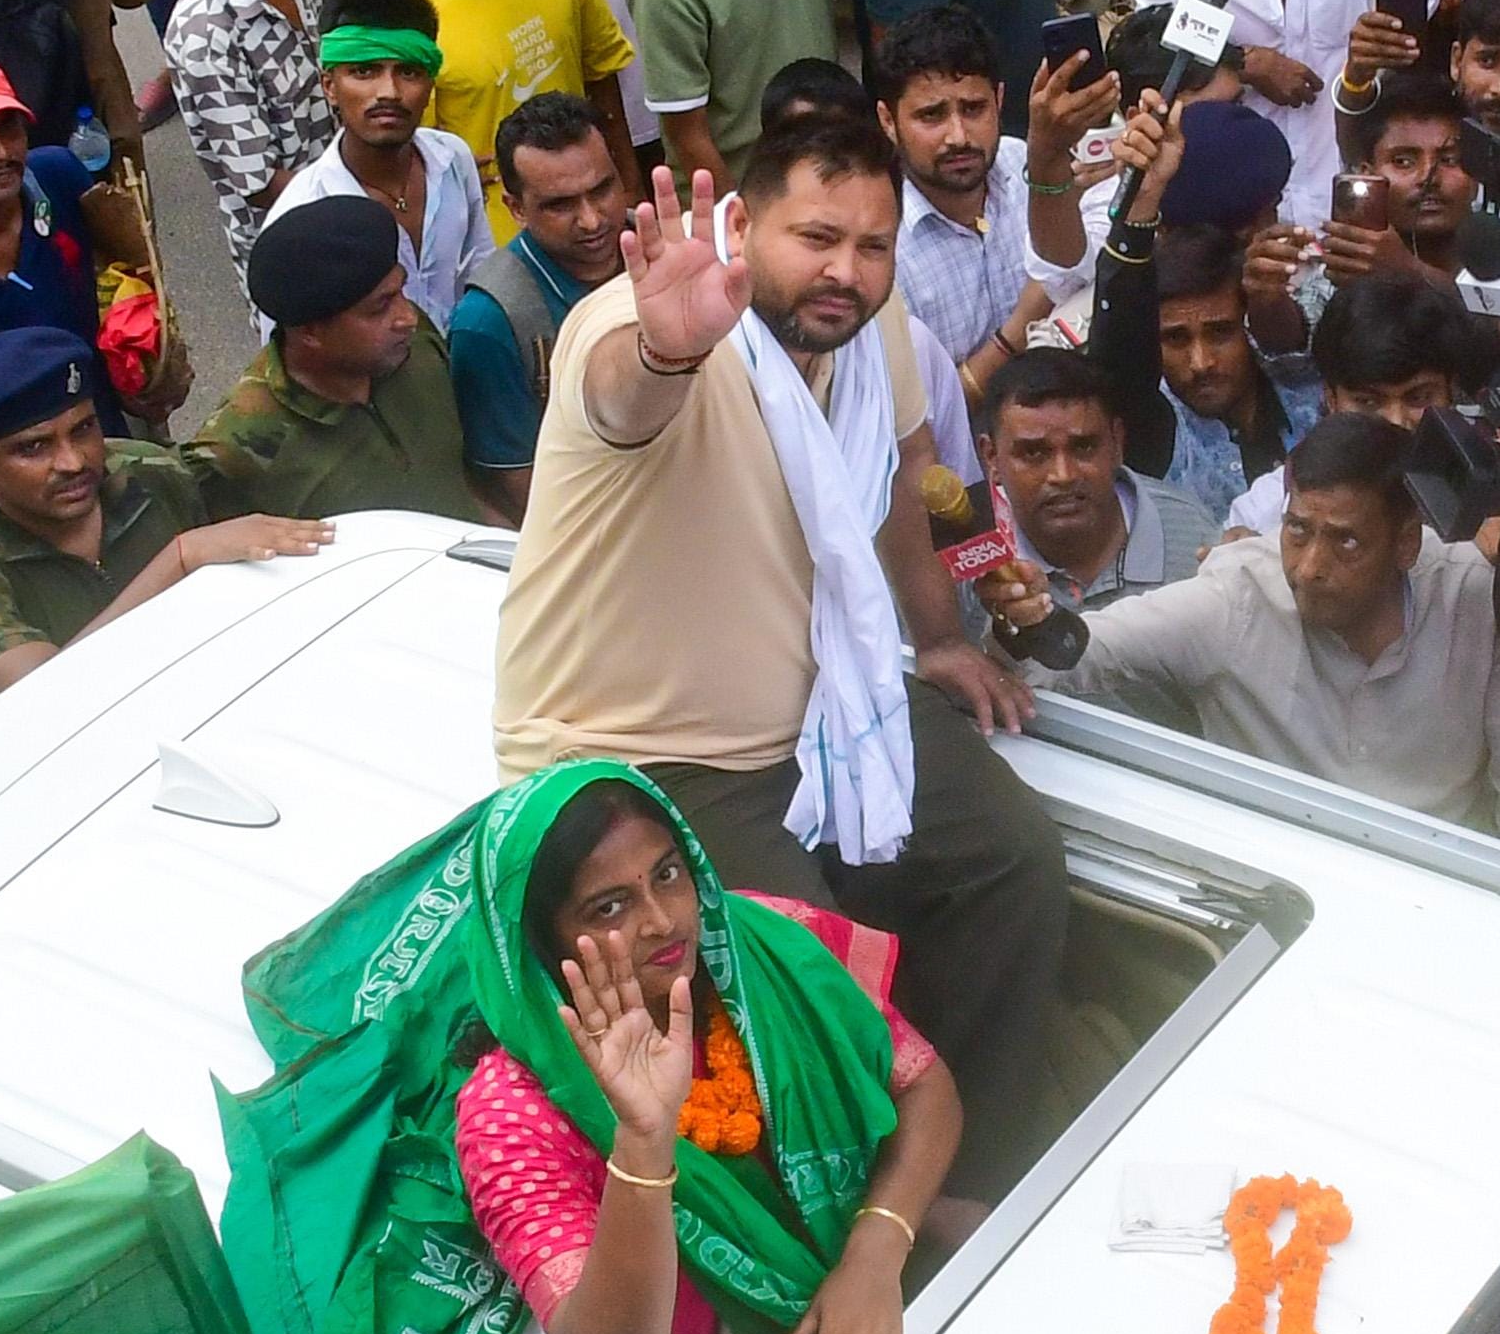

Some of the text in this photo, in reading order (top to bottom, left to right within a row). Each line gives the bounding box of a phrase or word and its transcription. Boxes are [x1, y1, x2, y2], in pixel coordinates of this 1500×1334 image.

[508, 15, 544, 42] WORK
[514, 29, 547, 53] HARD
[954, 543, 1008, 571] TODAY
[958, 541, 998, 561] INDIA
